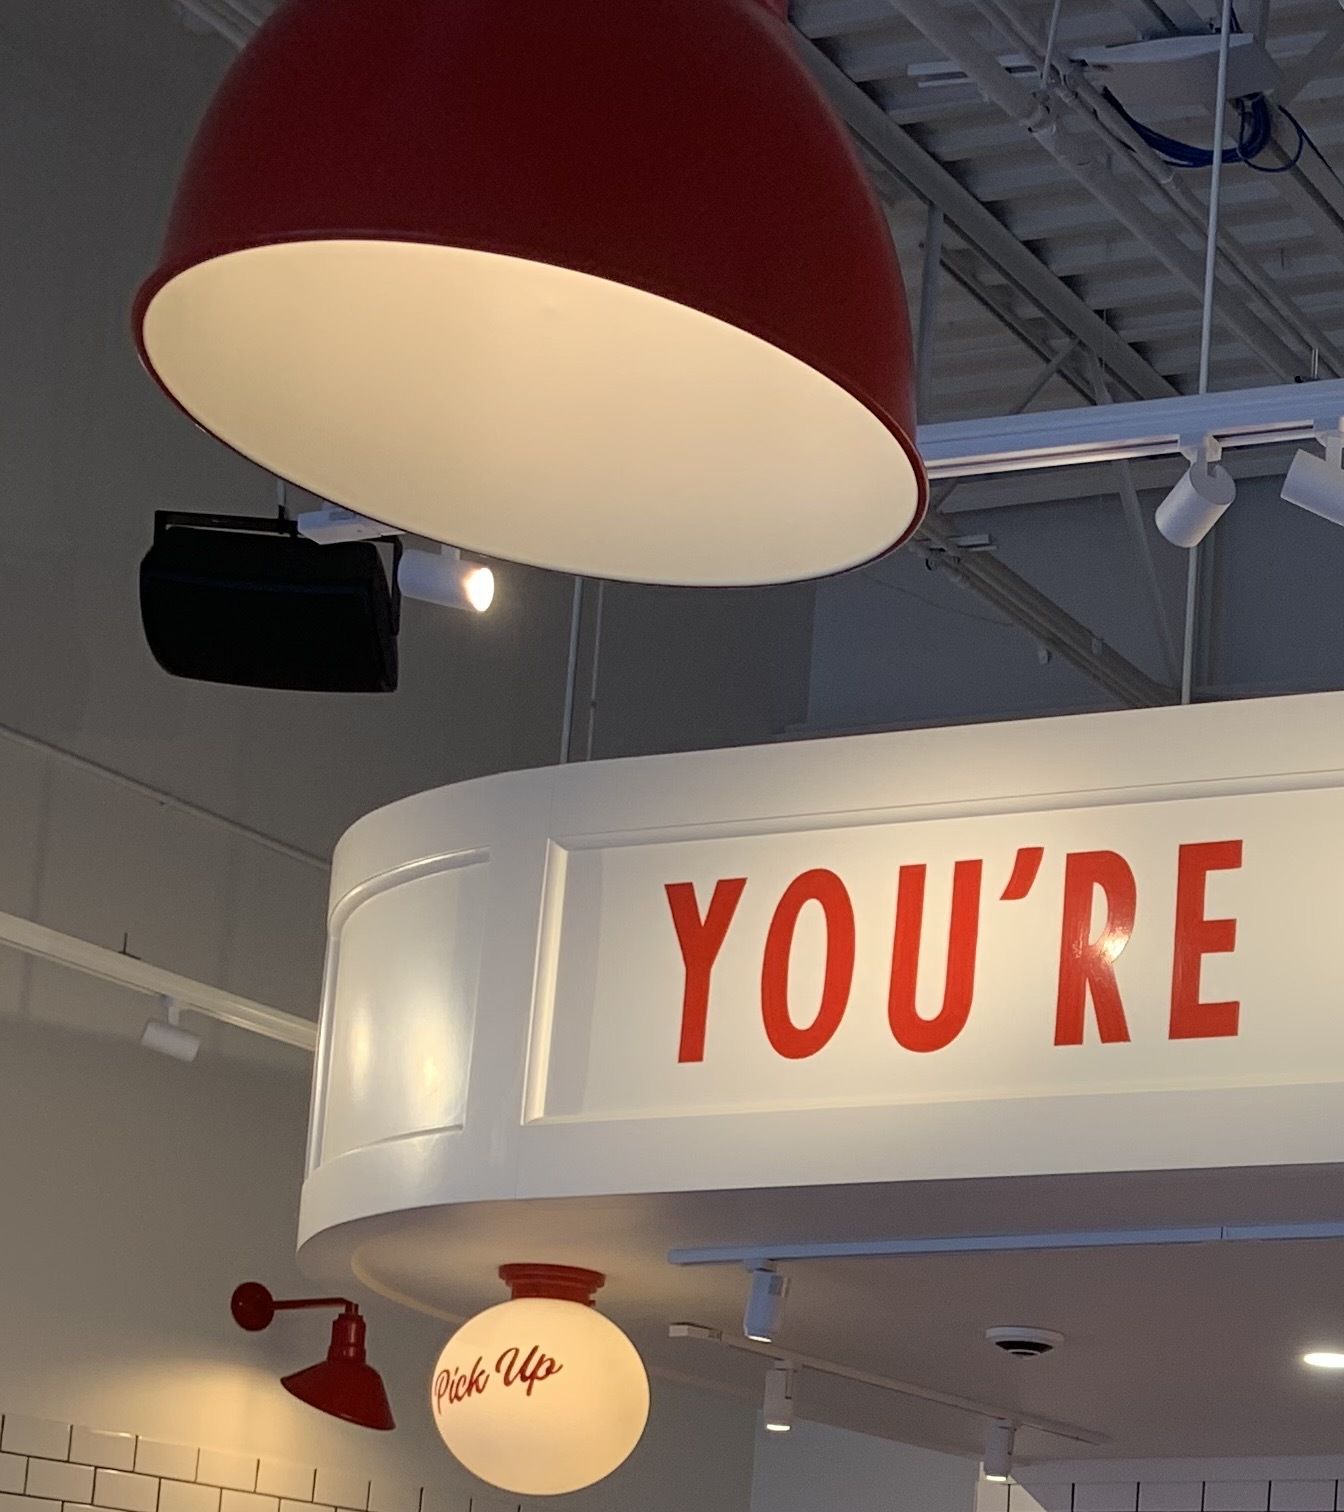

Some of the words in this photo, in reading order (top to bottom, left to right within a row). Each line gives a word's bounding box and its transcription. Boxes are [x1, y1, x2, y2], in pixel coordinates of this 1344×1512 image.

[663, 838, 1243, 1063] YOU'RE
[435, 1356, 489, 1414] Pick
[495, 1345, 563, 1396] Up
